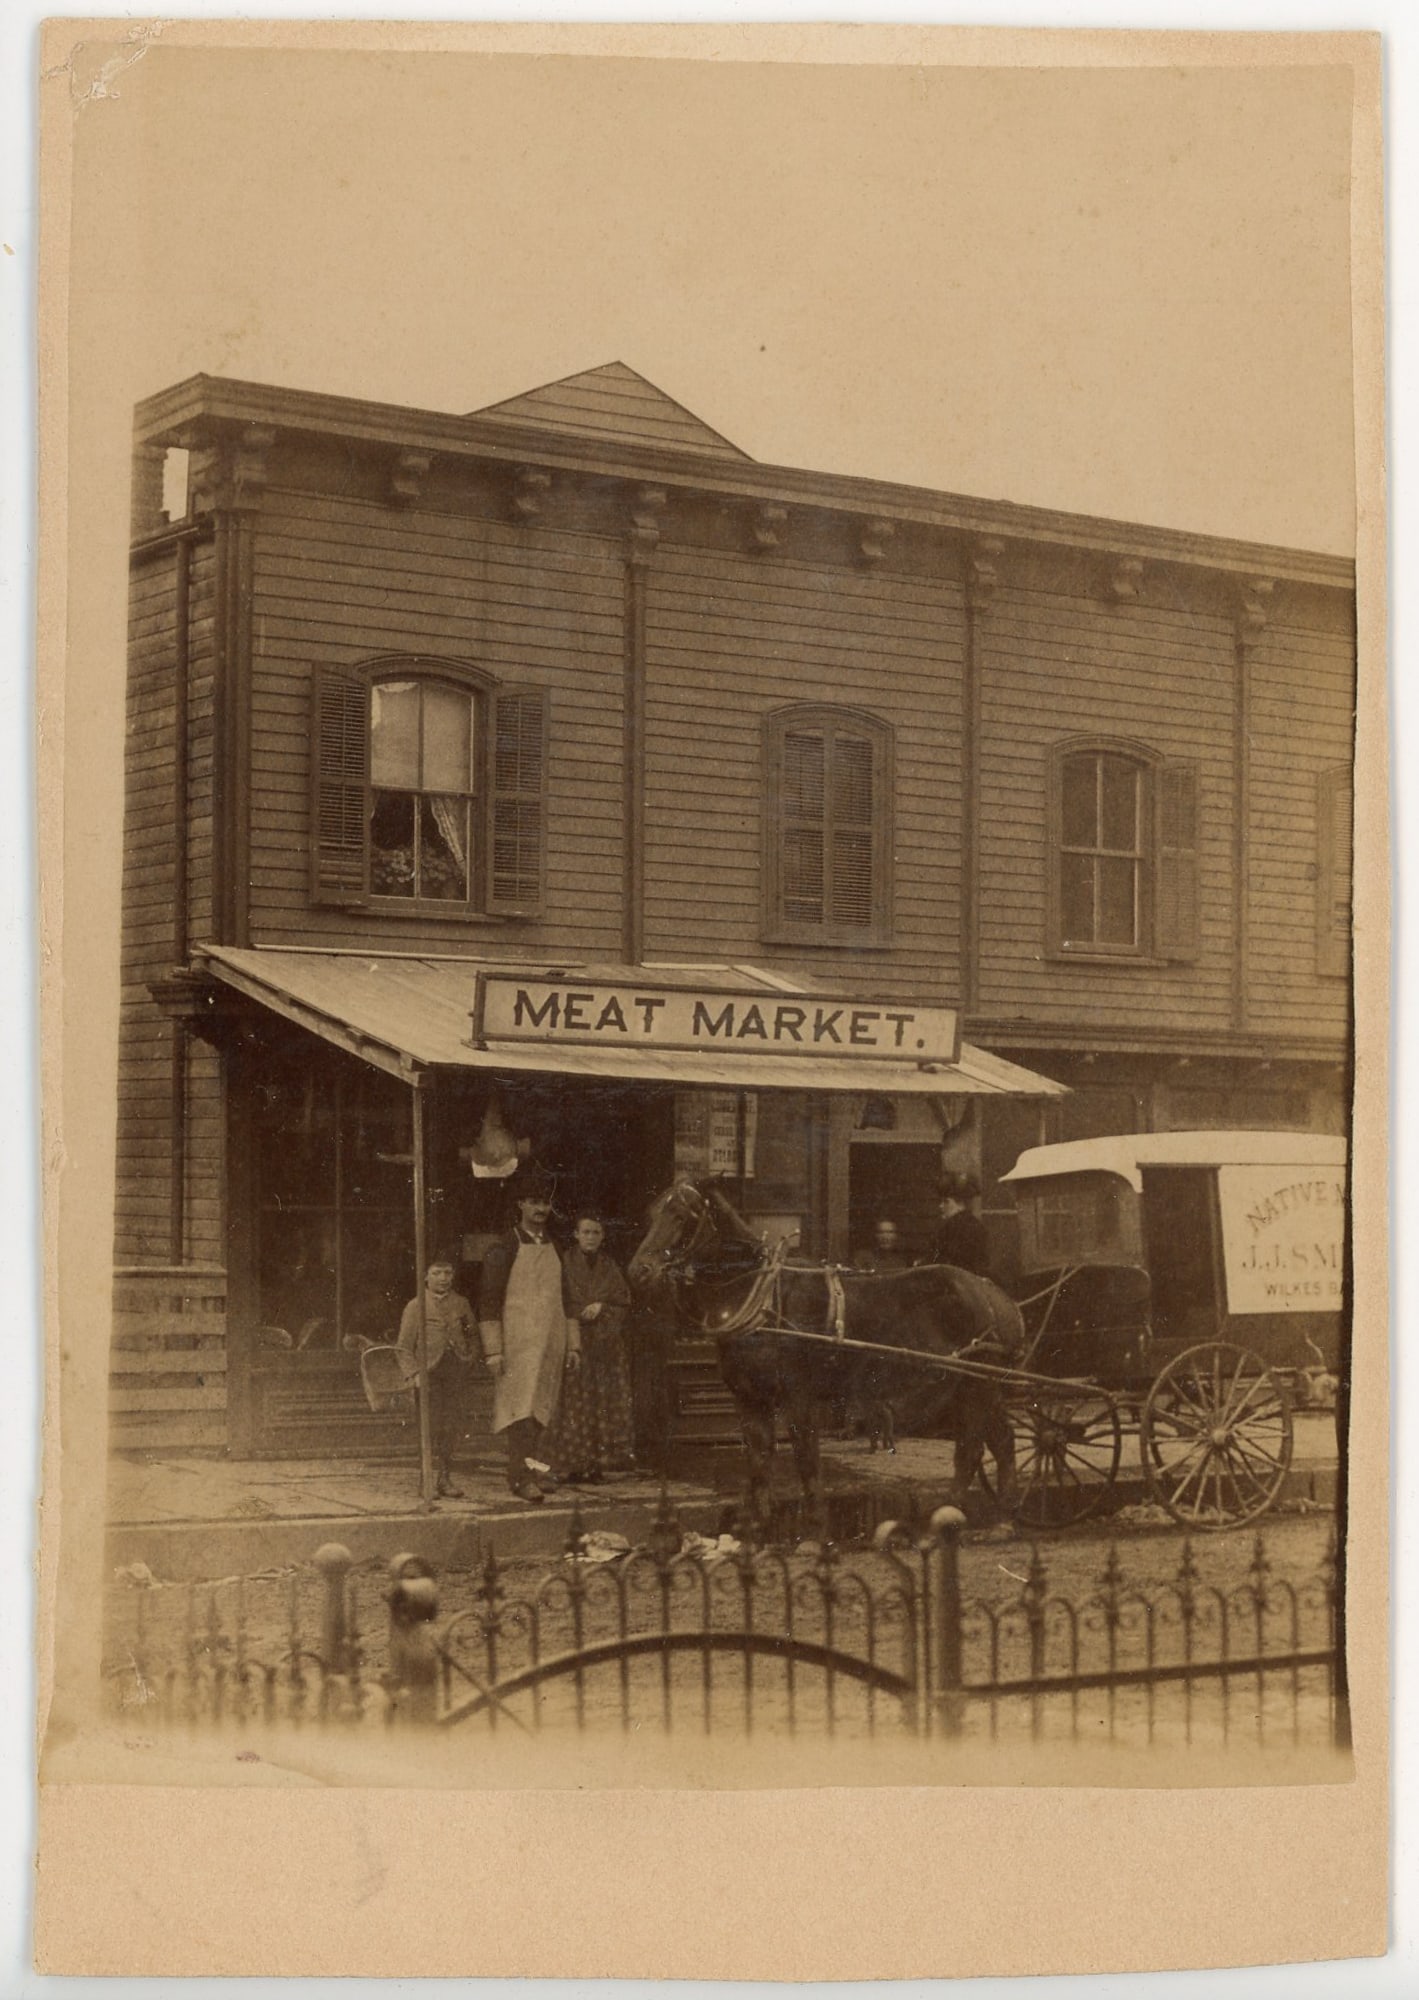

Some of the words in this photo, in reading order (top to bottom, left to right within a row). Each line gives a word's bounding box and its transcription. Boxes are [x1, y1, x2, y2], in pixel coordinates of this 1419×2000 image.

[514, 989, 666, 1033] MEAT
[692, 1000, 925, 1049] MARKET.
[1246, 1181, 1328, 1236] NATIVE
[1265, 1281, 1322, 1296] WILKES
